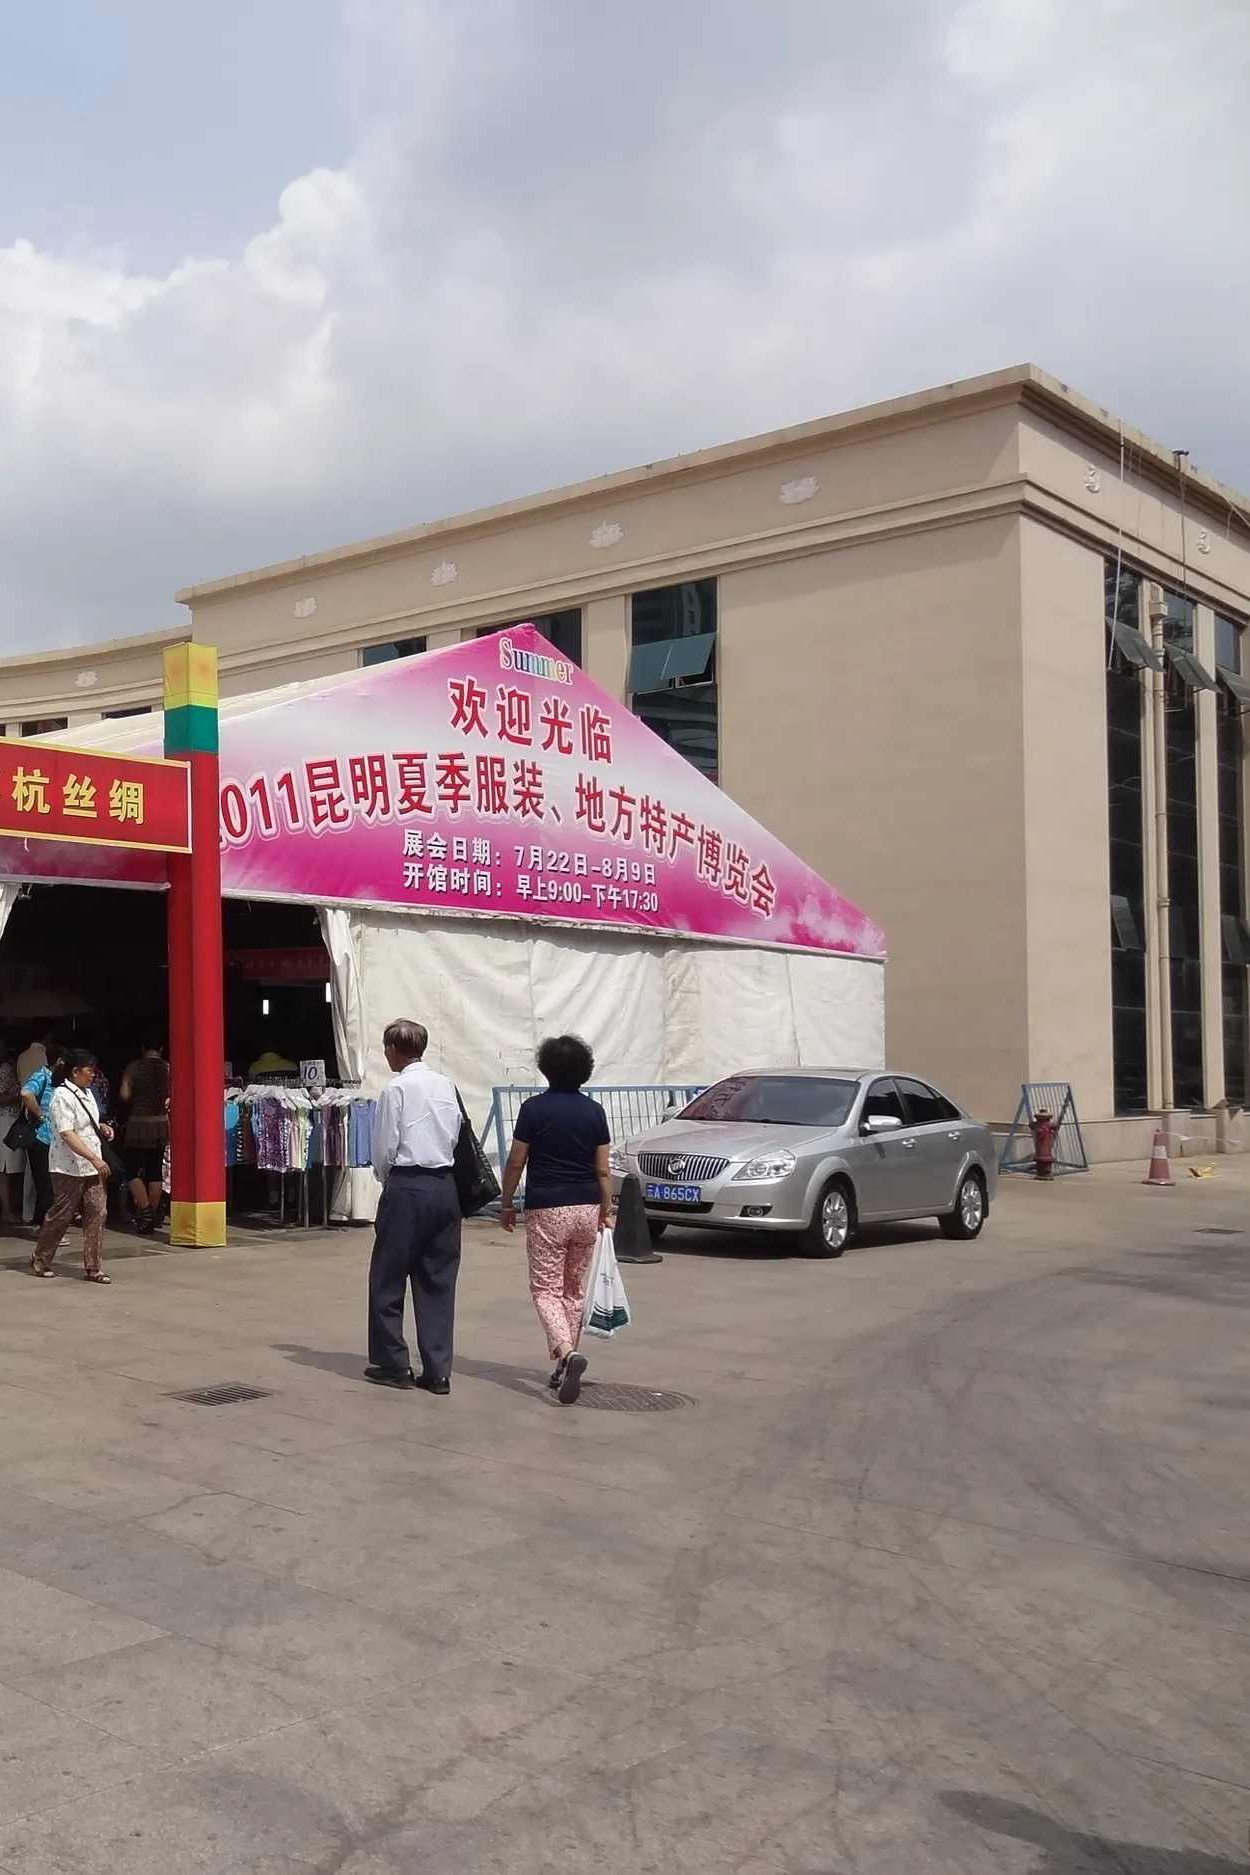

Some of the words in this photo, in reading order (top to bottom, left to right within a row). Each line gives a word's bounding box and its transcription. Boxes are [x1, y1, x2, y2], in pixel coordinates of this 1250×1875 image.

[500, 637, 574, 685] Summer
[448, 677, 613, 764] 欢迎光临
[219, 751, 778, 918] 011昆明夏季服装、地方特产博览会
[304, 1066, 317, 1080] 10
